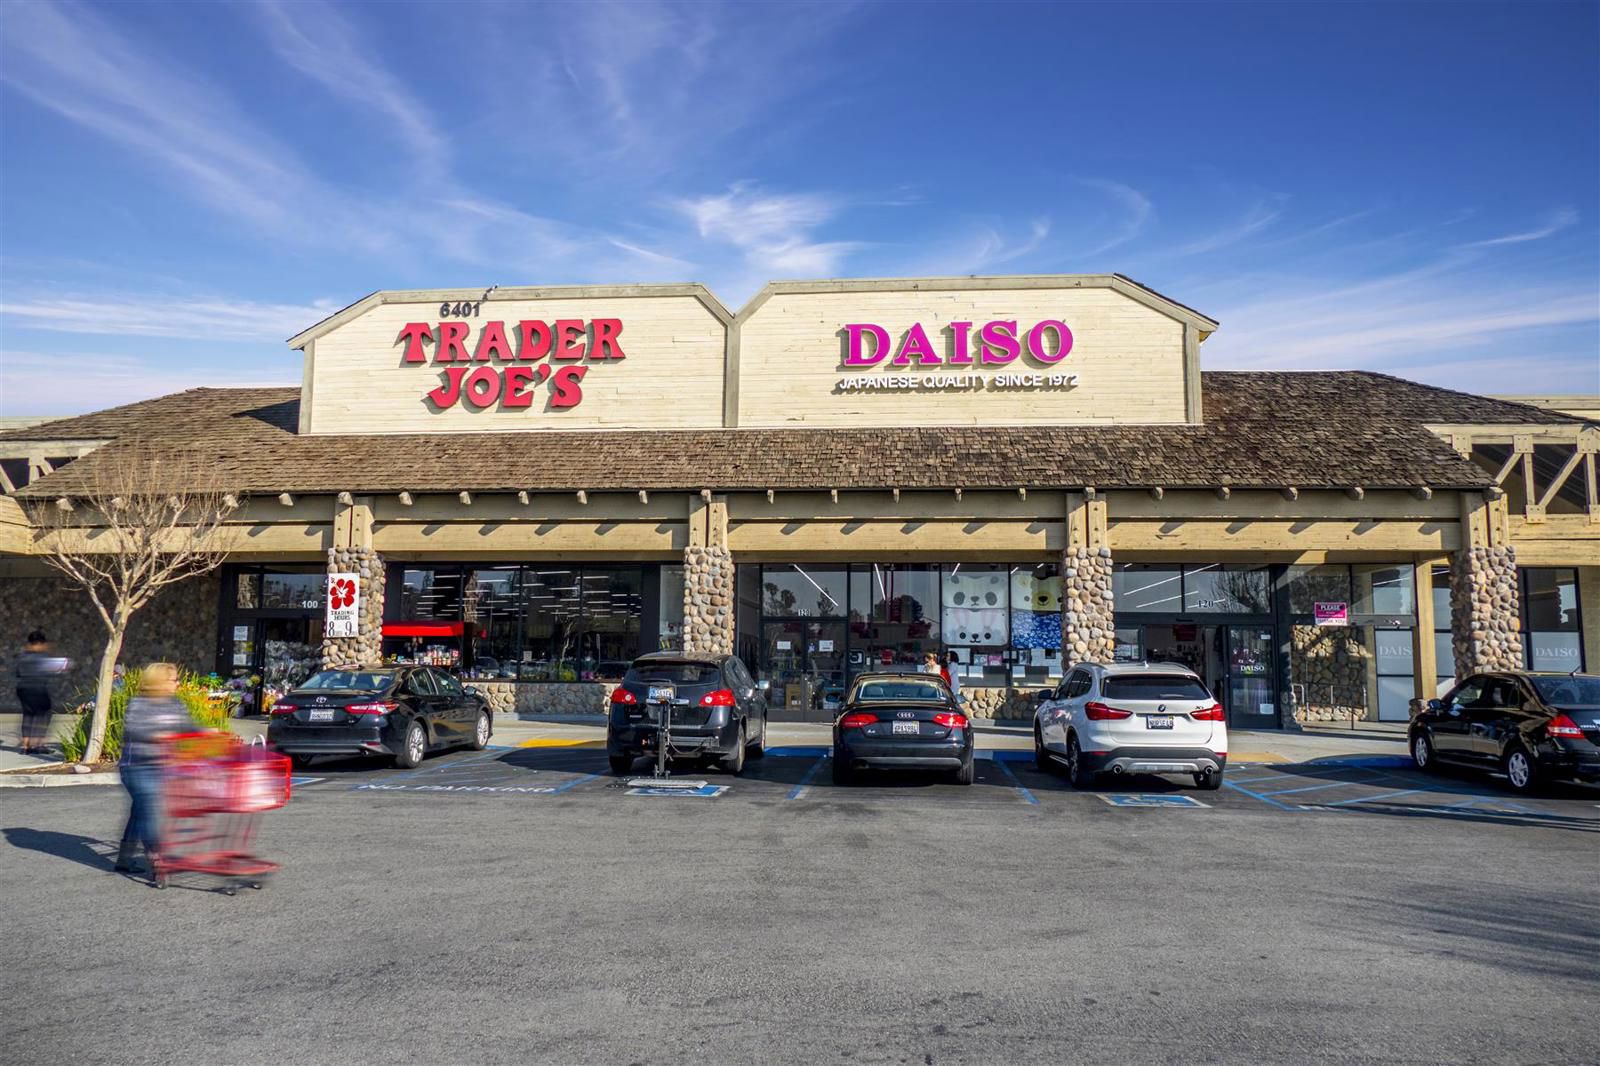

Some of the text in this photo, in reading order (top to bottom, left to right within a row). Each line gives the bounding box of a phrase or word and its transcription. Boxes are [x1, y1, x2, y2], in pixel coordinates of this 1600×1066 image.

[440, 302, 480, 318] 6401
[399, 318, 626, 363] TRADER
[843, 319, 1074, 367] DAISO
[427, 363, 590, 409] JOE'S
[840, 374, 1079, 389] JAPANESE QUALITY SINCE 1972
[302, 600, 318, 608] 100
[1198, 600, 1214, 609] 120
[328, 621, 352, 637] 8 9
[1535, 647, 1578, 657] DAISO
